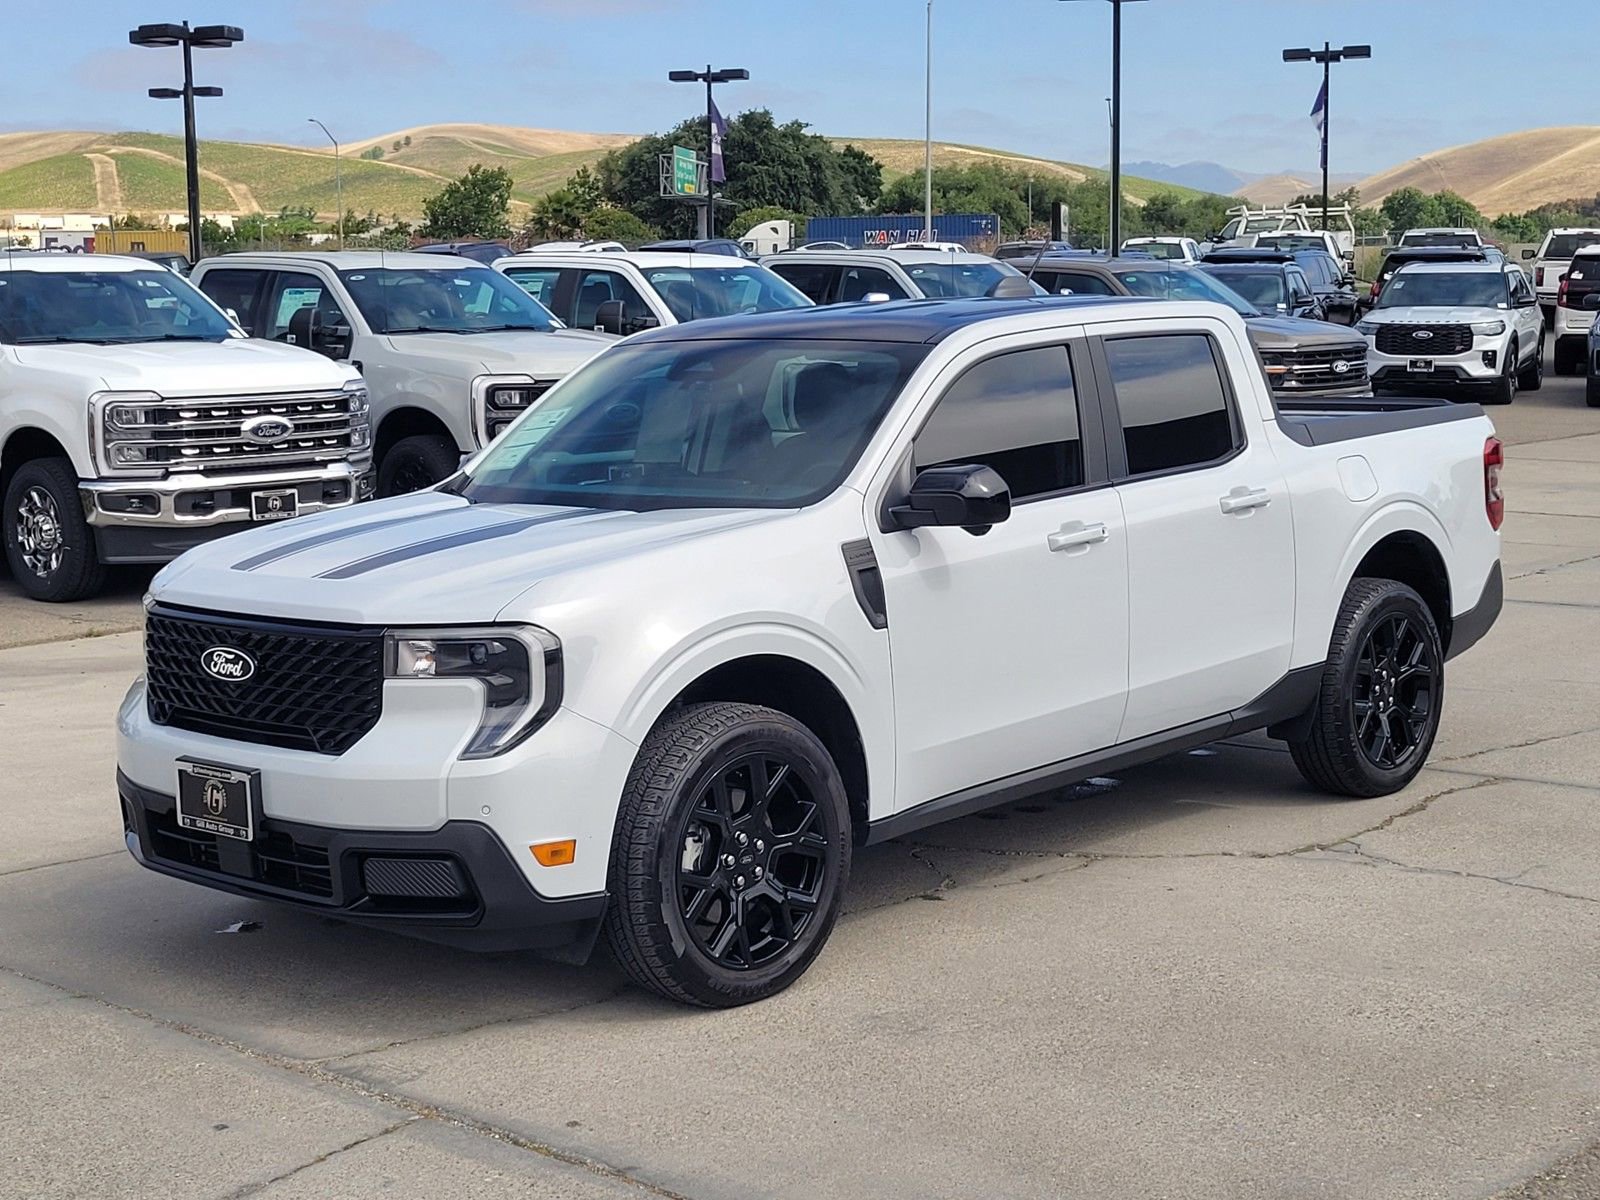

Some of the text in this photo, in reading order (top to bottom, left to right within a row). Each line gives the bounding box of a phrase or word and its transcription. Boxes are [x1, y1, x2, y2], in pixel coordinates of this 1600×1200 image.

[864, 229, 938, 244] WAN HAI
[258, 423, 281, 436] Ford
[211, 651, 243, 677] Ford
[196, 820, 234, 836] Gill Auto Group
